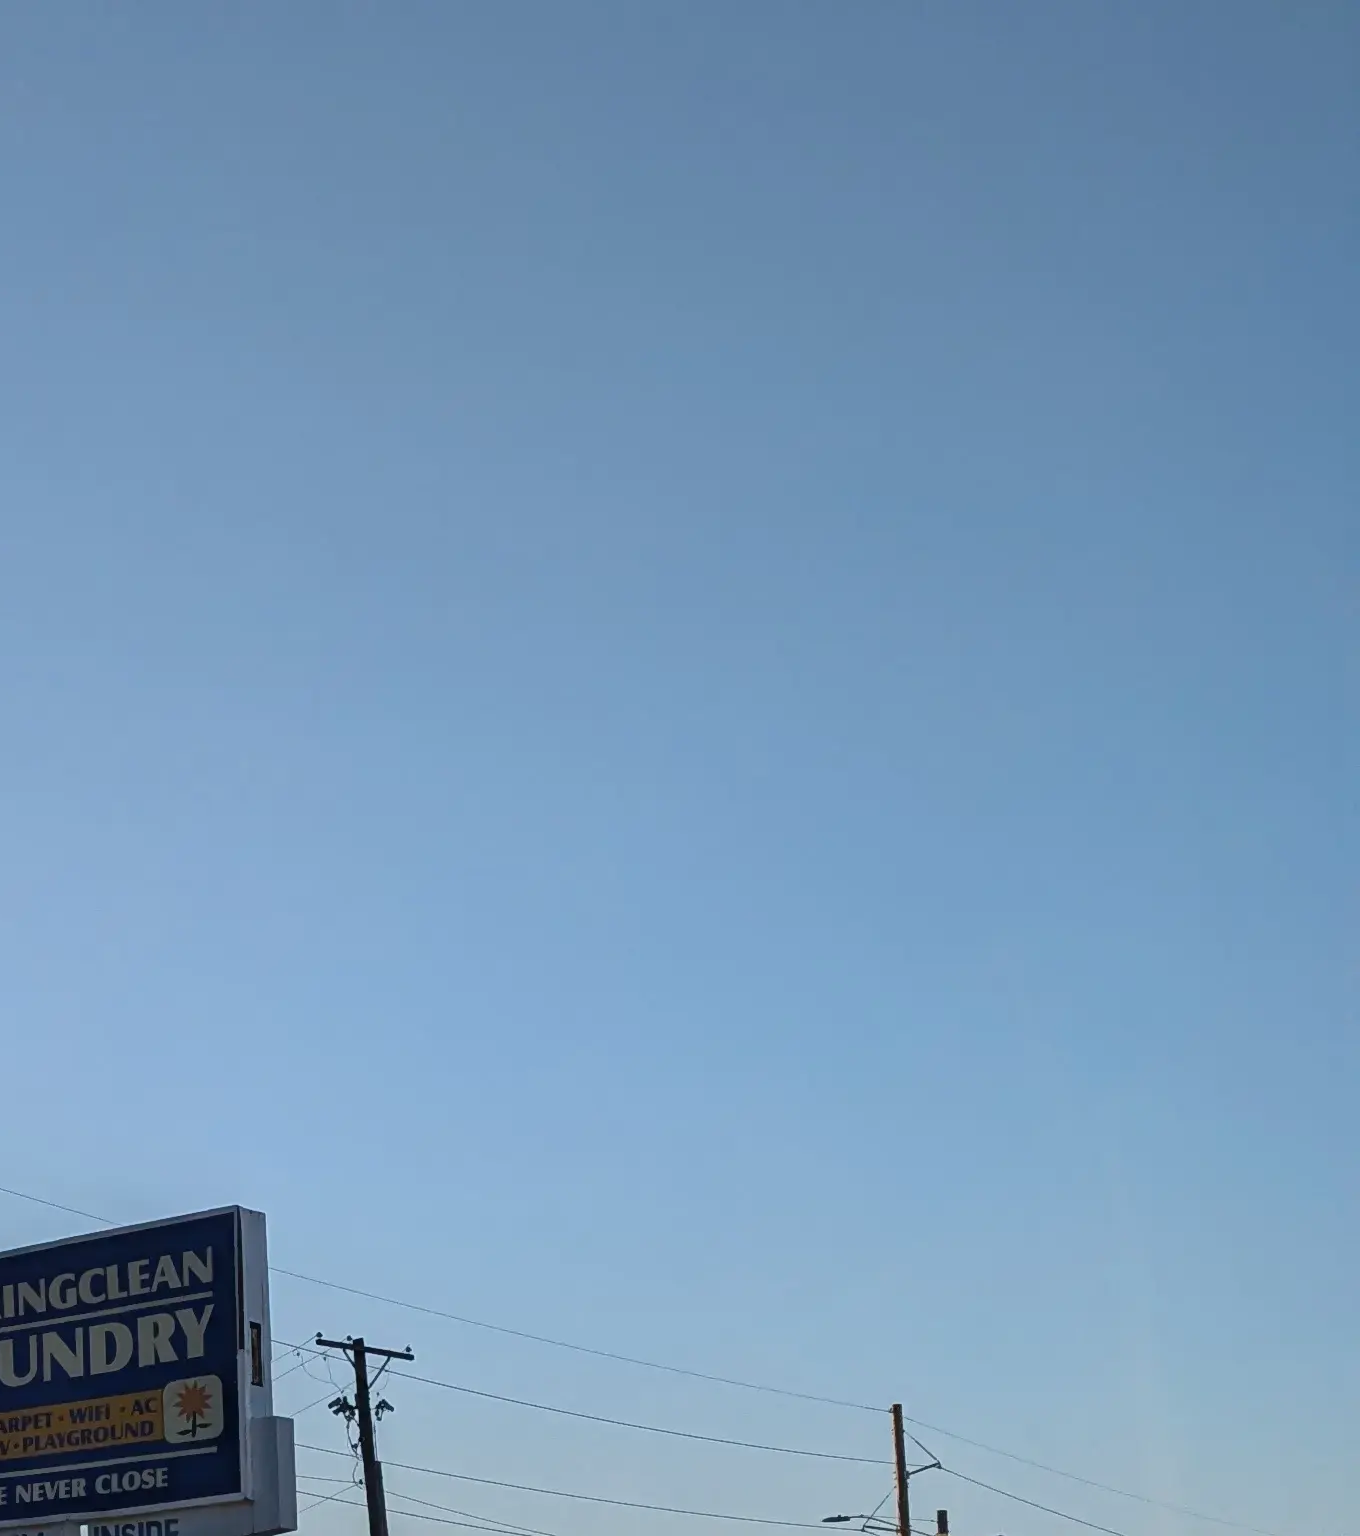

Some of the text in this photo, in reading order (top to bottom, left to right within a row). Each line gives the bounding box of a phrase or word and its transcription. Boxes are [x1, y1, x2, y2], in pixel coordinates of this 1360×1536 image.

[69, 1403, 111, 1424] WIFI
[130, 1397, 157, 1415] AC
[22, 1420, 154, 1451] PLAYGROUND
[15, 1478, 87, 1504] NEVER
[95, 1467, 169, 1495] CLOSE
